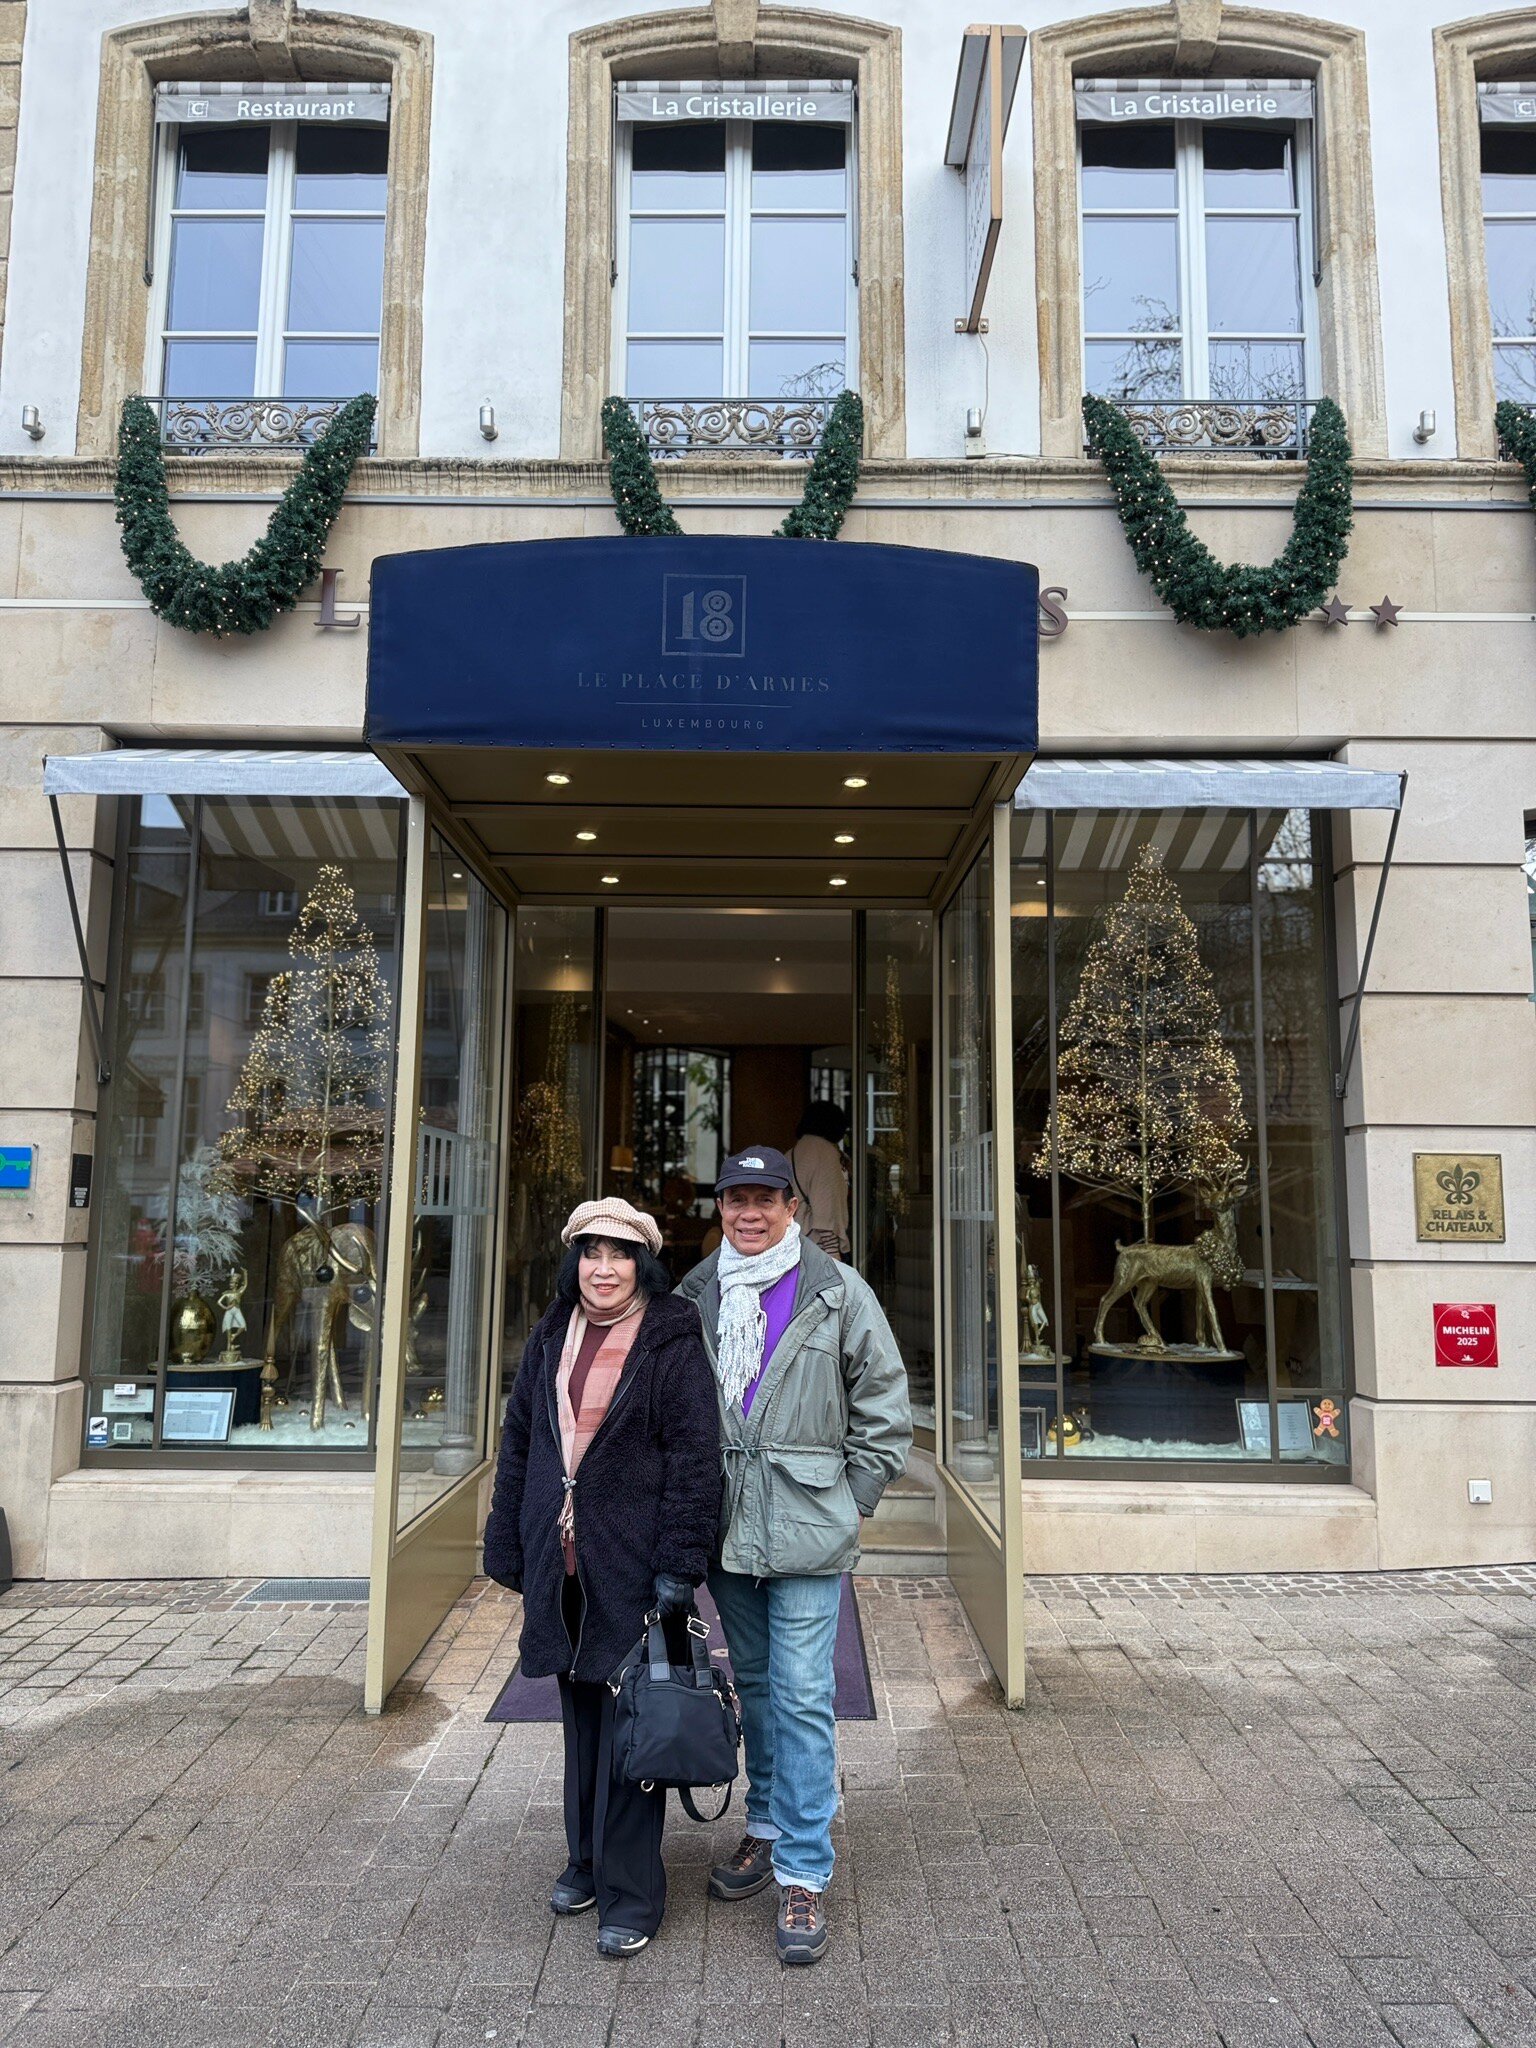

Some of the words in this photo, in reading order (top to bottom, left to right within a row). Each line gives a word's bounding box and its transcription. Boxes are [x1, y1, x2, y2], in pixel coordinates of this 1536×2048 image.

[237, 100, 356, 117] Restaurant
[652, 97, 679, 116] La
[685, 96, 817, 117] Cristallerie
[1110, 96, 1138, 117] La
[1144, 93, 1278, 115] Cristallerie
[675, 590, 734, 642] 18
[577, 672, 607, 688] LE
[621, 672, 703, 690] PLACE
[716, 673, 831, 693] D'ARMES
[641, 718, 765, 731] LUXEMBOURG
[1432, 1209, 1476, 1220] RELAIS
[1477, 1209, 1488, 1221] &
[1442, 1326, 1490, 1335] MICHELIN
[1456, 1337, 1478, 1346] 2025
